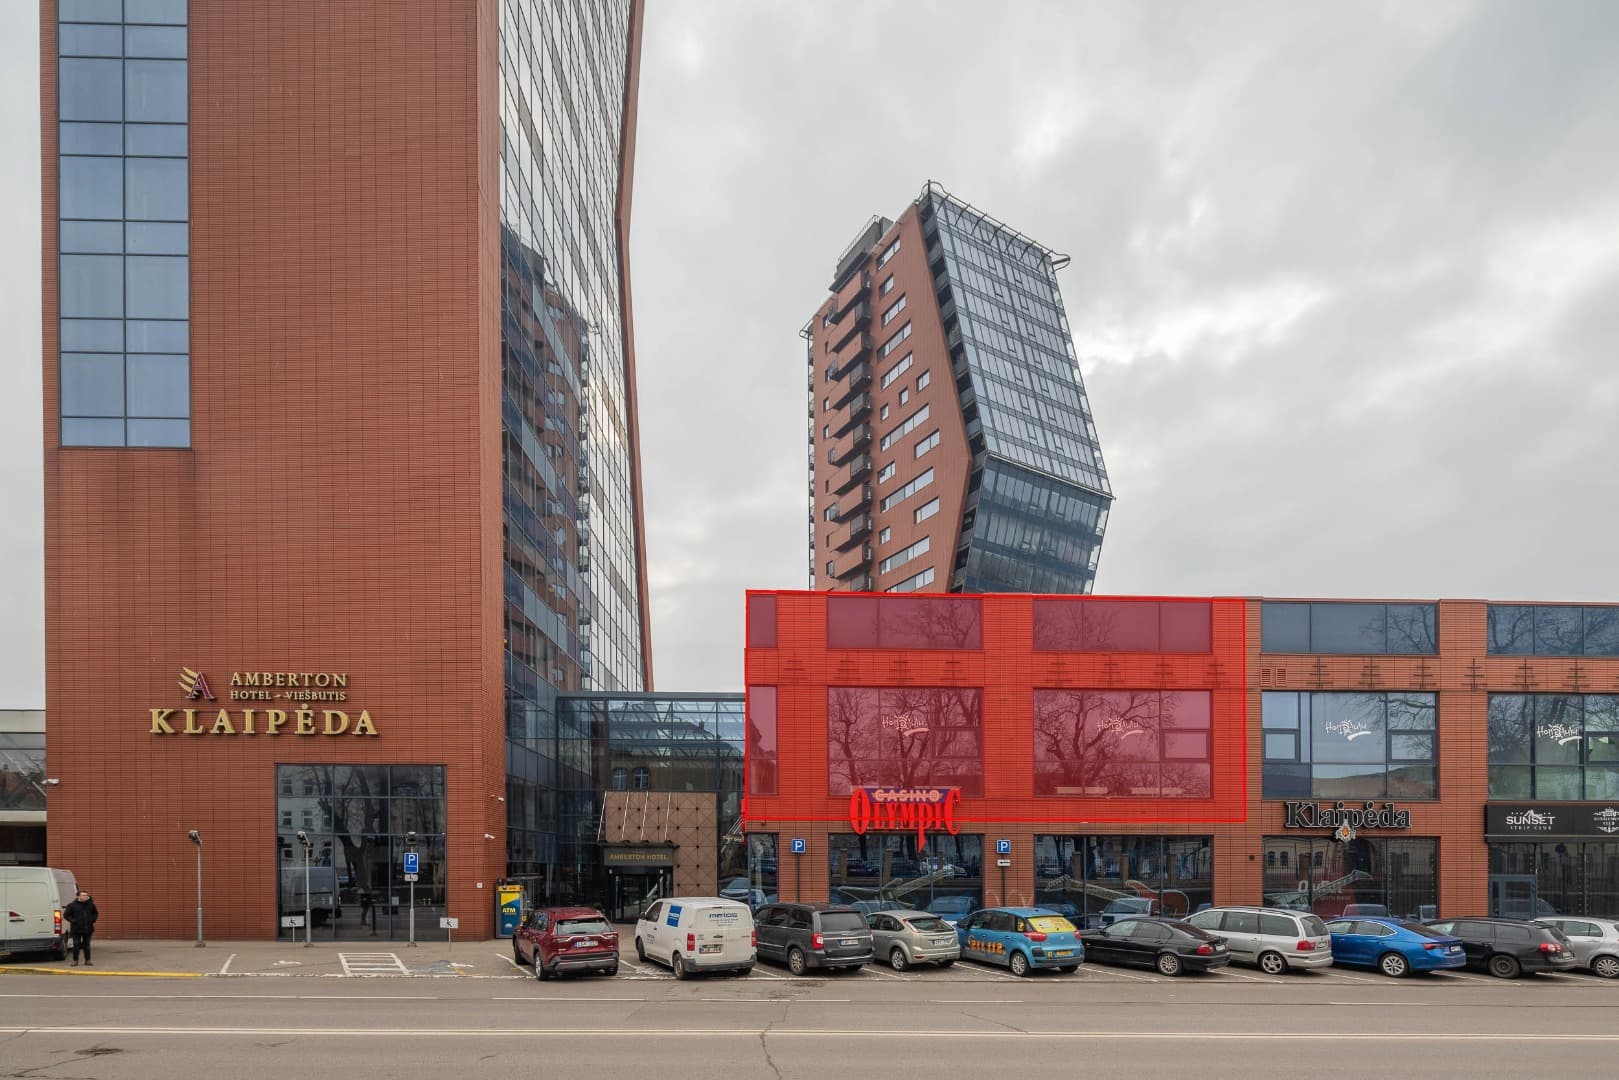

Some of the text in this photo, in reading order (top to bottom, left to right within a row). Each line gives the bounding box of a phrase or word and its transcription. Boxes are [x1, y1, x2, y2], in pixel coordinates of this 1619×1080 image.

[230, 671, 347, 687] AMBERTON
[230, 688, 346, 701] HOTEL VIEŠBUTIS
[149, 703, 378, 735] KLAIPĖDA
[873, 789, 942, 802] CASINO
[1285, 800, 1411, 828] Klaipėda
[1506, 815, 1556, 825] SUNSET
